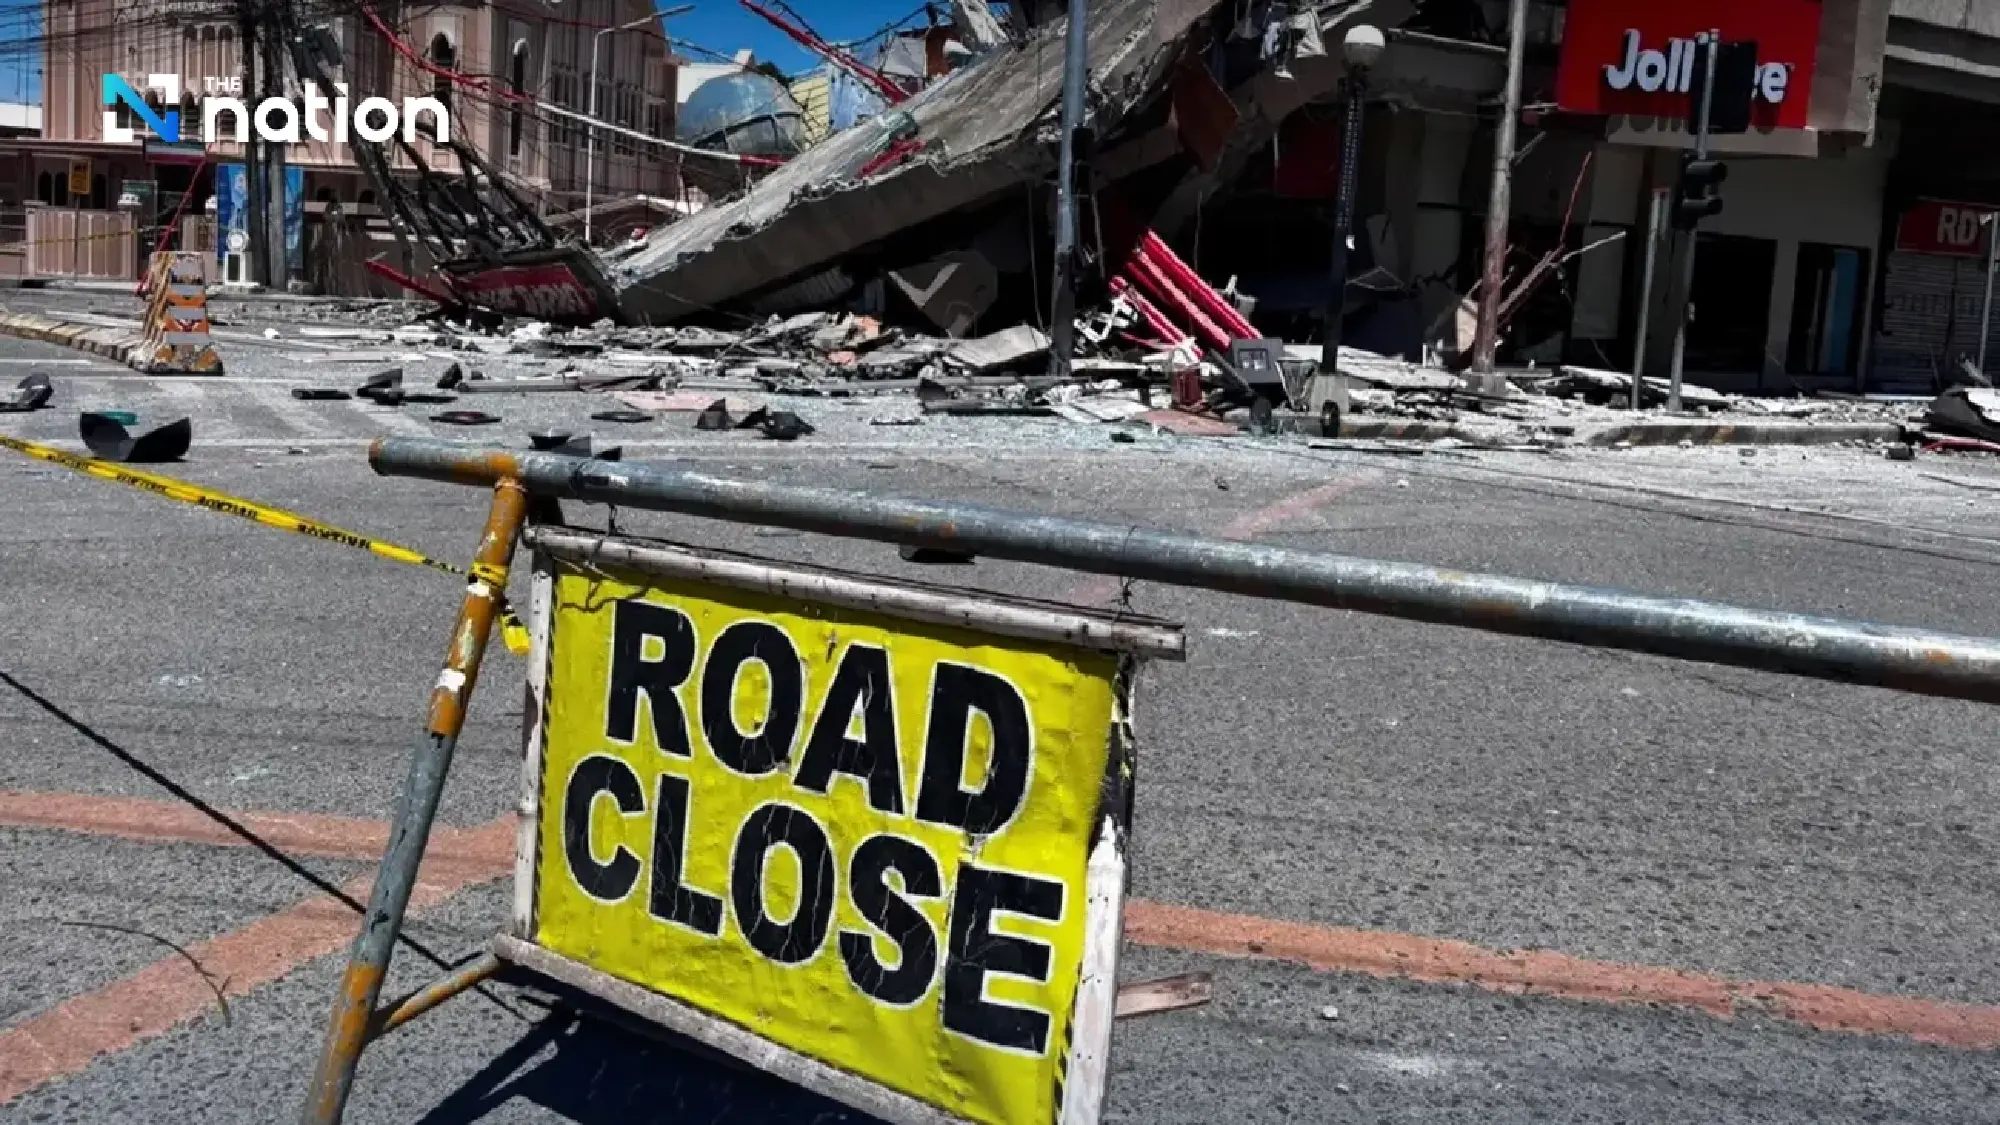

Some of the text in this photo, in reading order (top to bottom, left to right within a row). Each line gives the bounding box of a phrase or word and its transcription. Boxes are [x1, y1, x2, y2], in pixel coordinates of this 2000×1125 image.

[1602, 28, 1788, 104] Jolle
[606, 599, 1032, 836] ROAD
[564, 756, 1065, 1054] CLOSE
